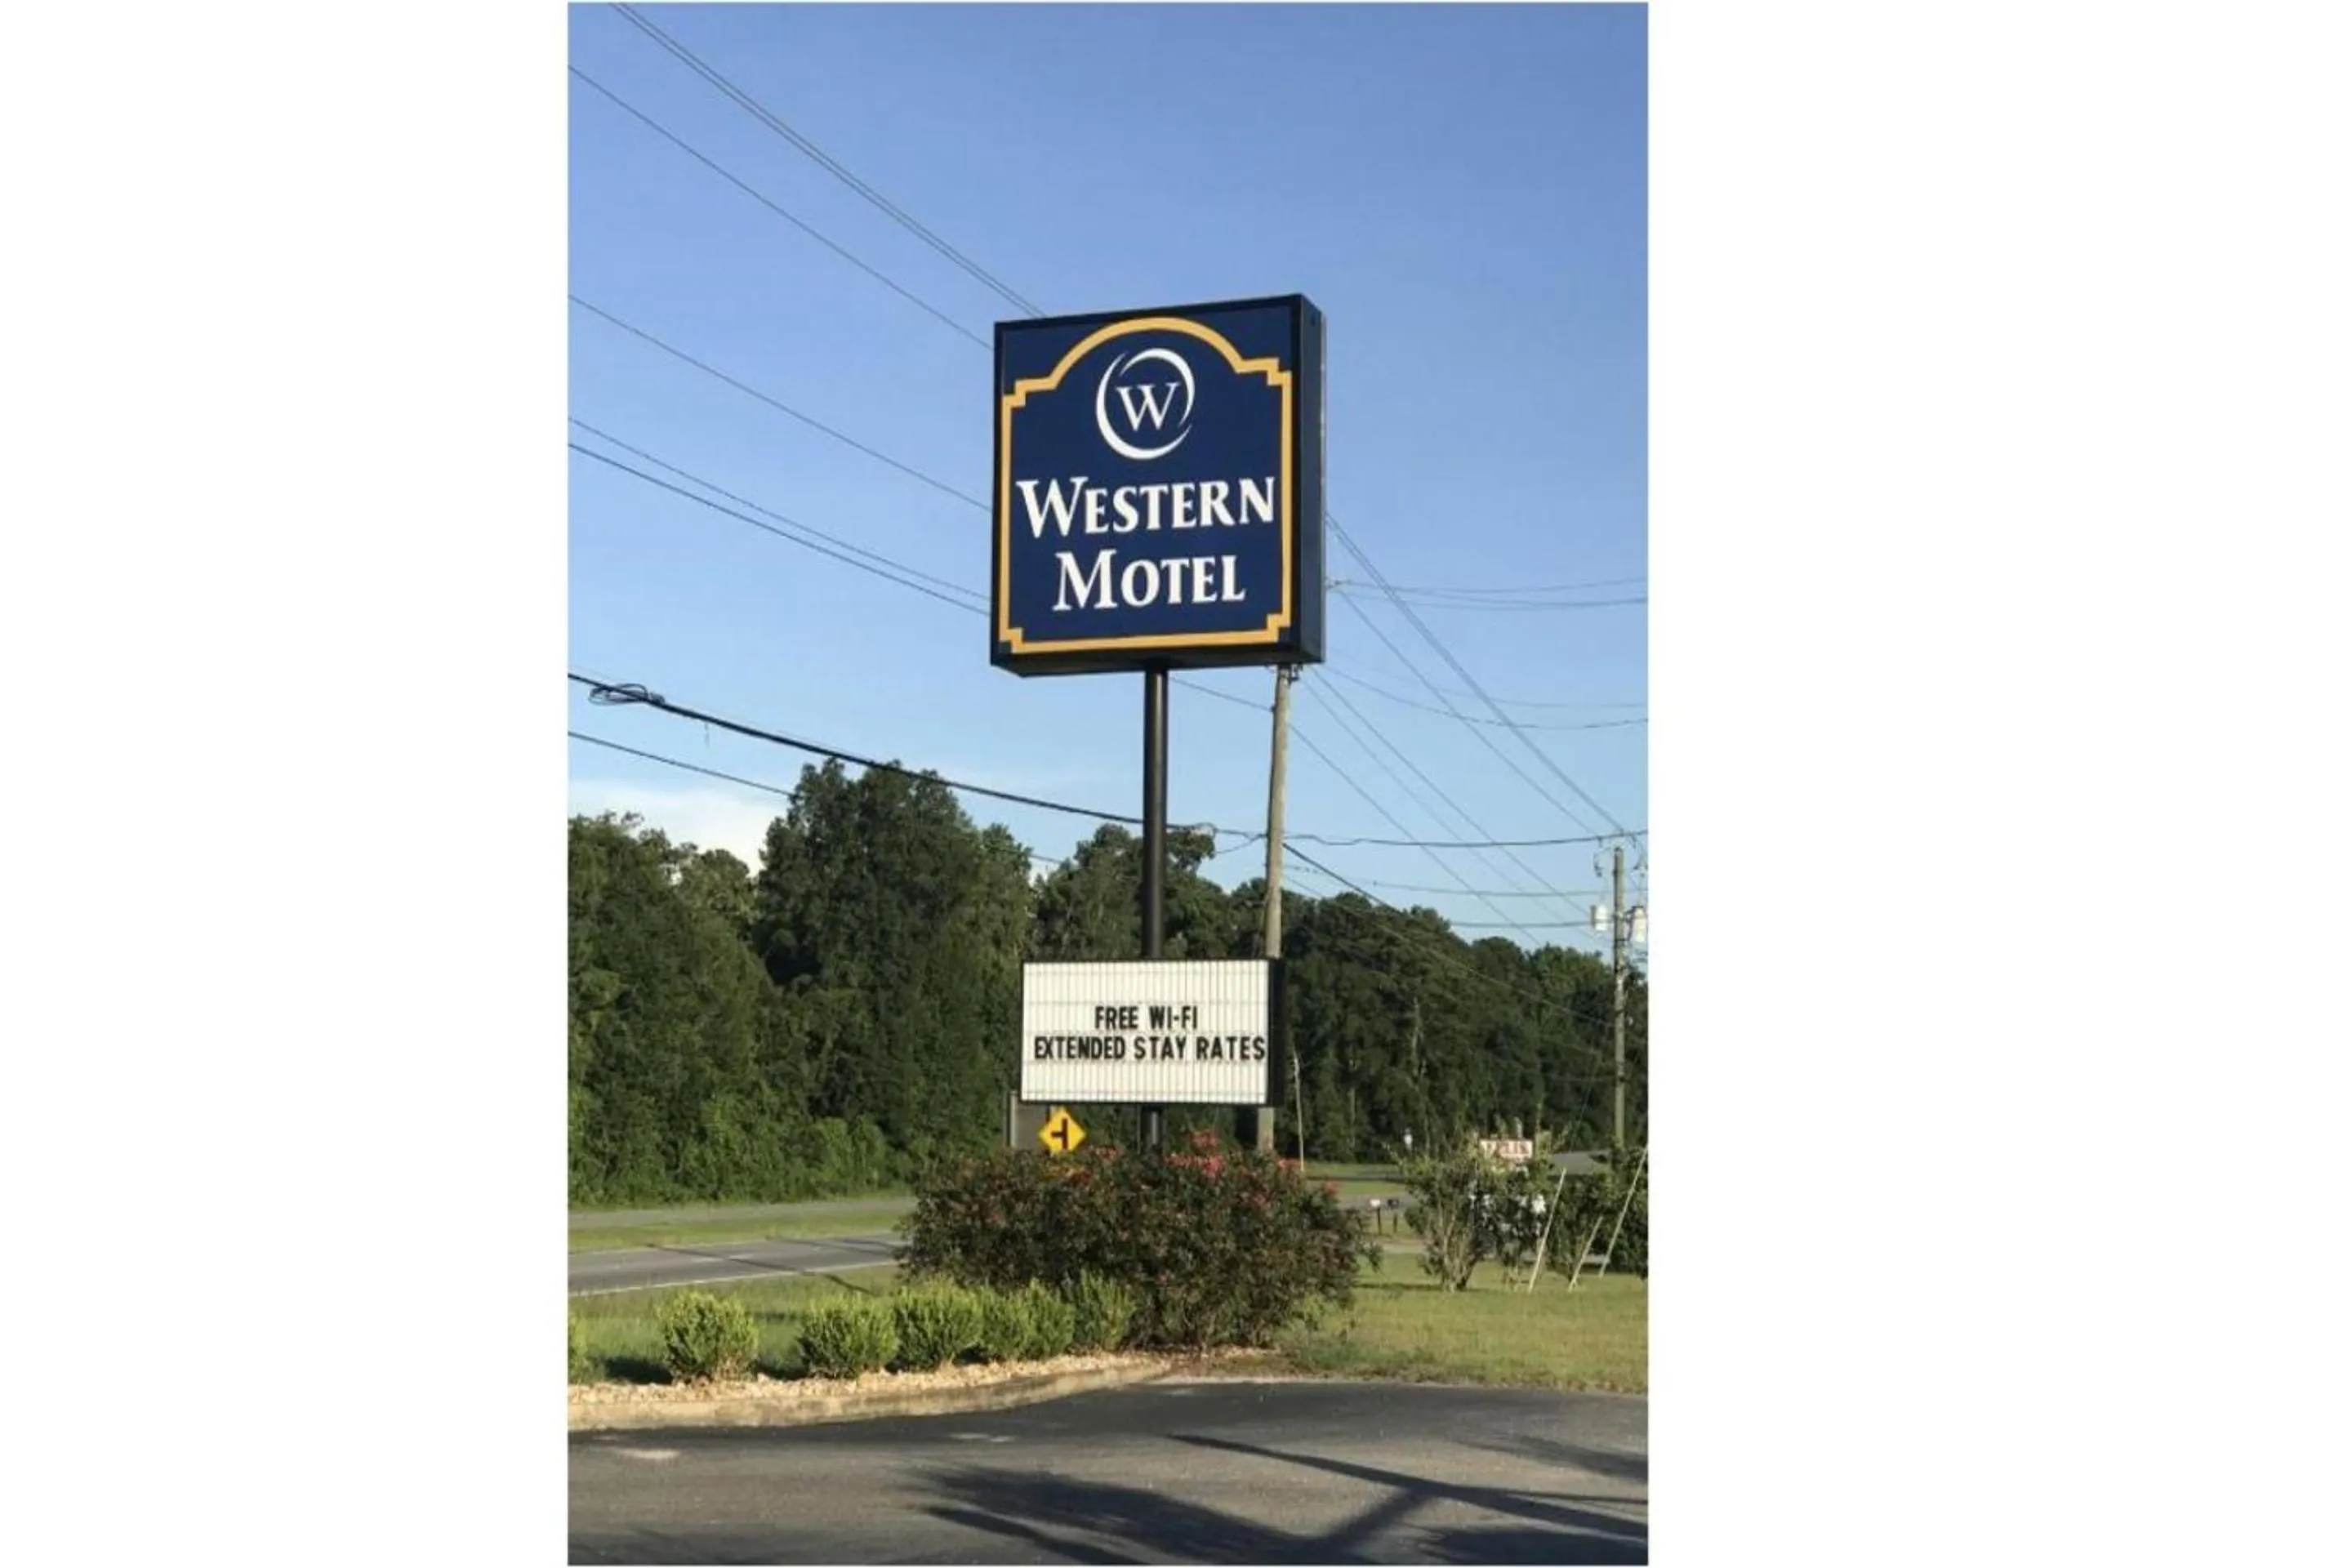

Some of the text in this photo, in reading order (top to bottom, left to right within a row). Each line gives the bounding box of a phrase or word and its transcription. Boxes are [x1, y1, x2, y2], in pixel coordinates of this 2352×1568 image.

[1116, 382, 1180, 432] W
[1016, 476, 1275, 538] WESTERN
[1053, 549, 1246, 611] MOTEL
[1095, 1005, 1198, 1029] FREE WI-FI
[1034, 1036, 1266, 1061] EXTENDED STAY RATES
